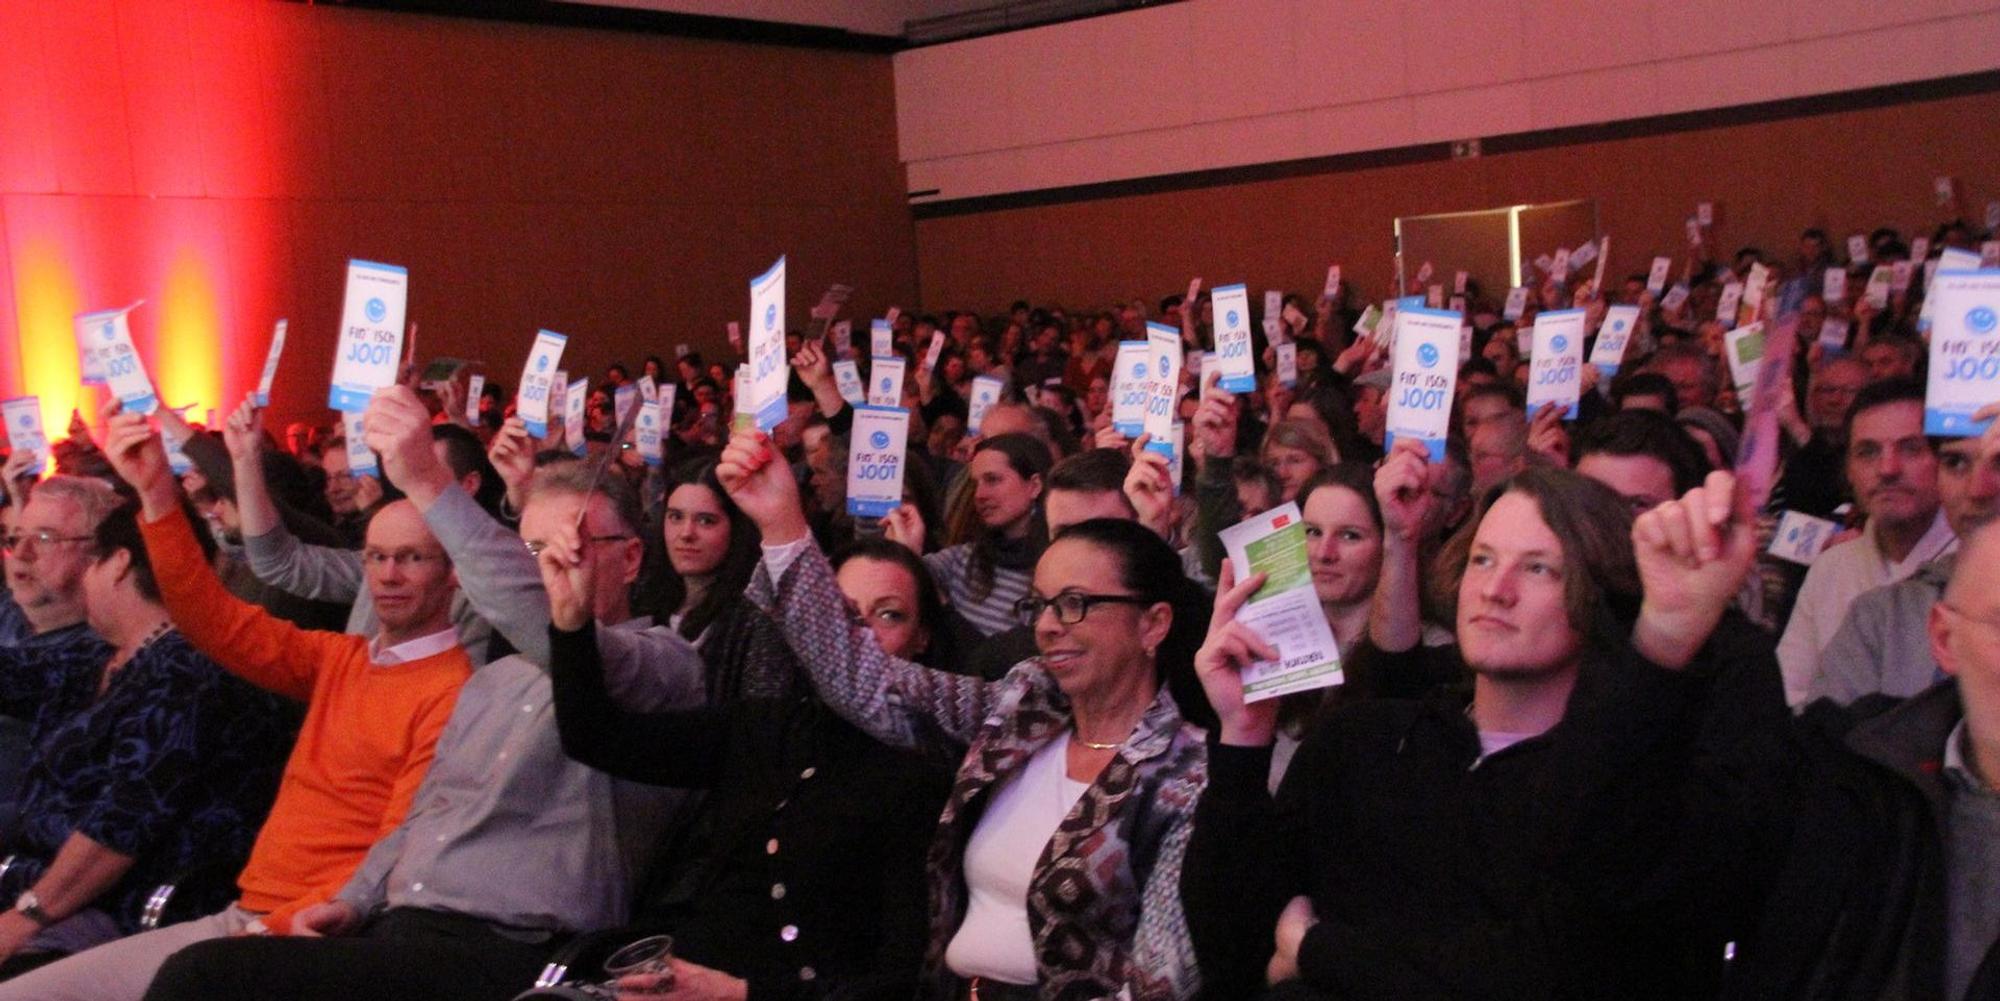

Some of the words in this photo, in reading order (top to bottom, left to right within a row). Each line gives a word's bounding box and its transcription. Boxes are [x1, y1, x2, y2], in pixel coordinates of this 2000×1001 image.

[347, 343, 393, 365] JOOT
[1537, 366, 1576, 384] JOOT
[1944, 355, 2000, 380] JOO
[1399, 387, 1445, 410] JOOT
[857, 464, 896, 480] JOOT
